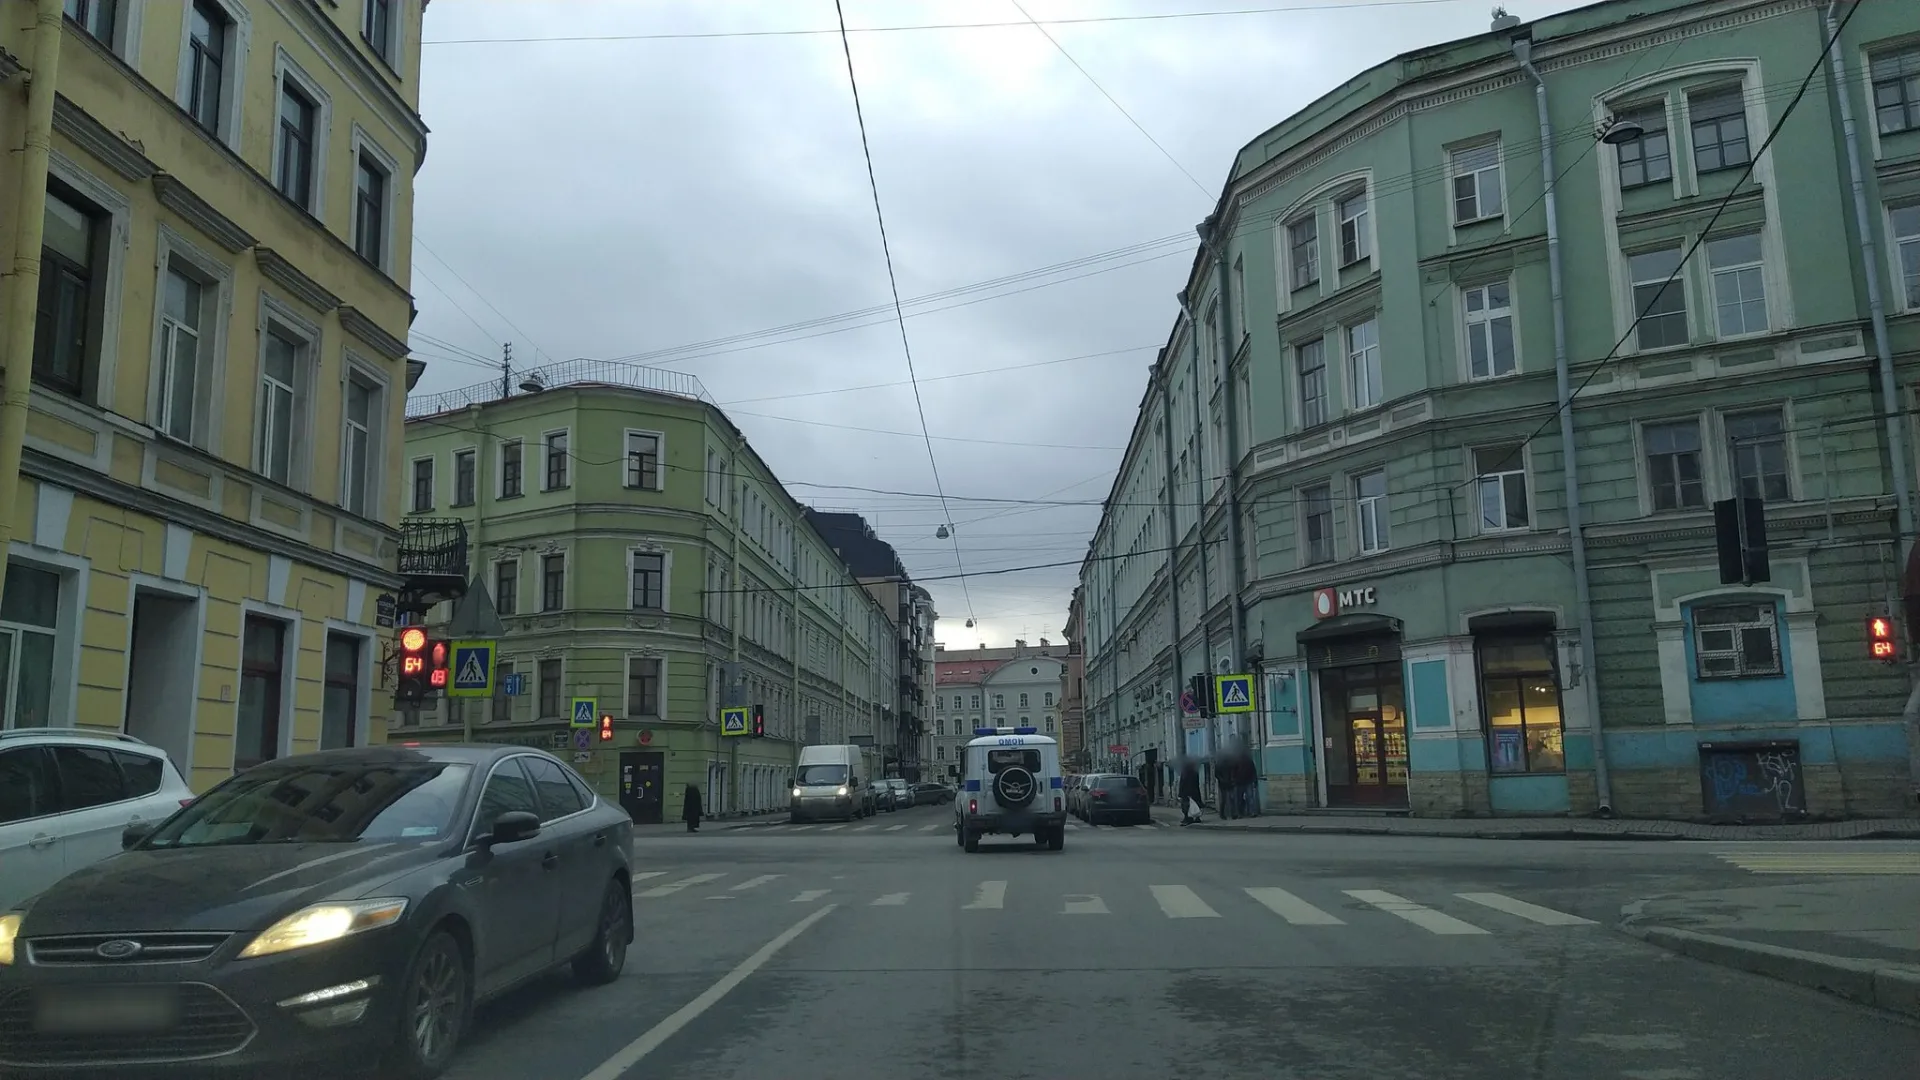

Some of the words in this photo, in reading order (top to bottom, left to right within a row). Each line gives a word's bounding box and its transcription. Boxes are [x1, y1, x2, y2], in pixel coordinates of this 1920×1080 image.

[1339, 587, 1375, 608] МТС
[1874, 641, 1891, 655] 64
[405, 657, 423, 673] 64
[998, 738, 1024, 746] ОМОН
